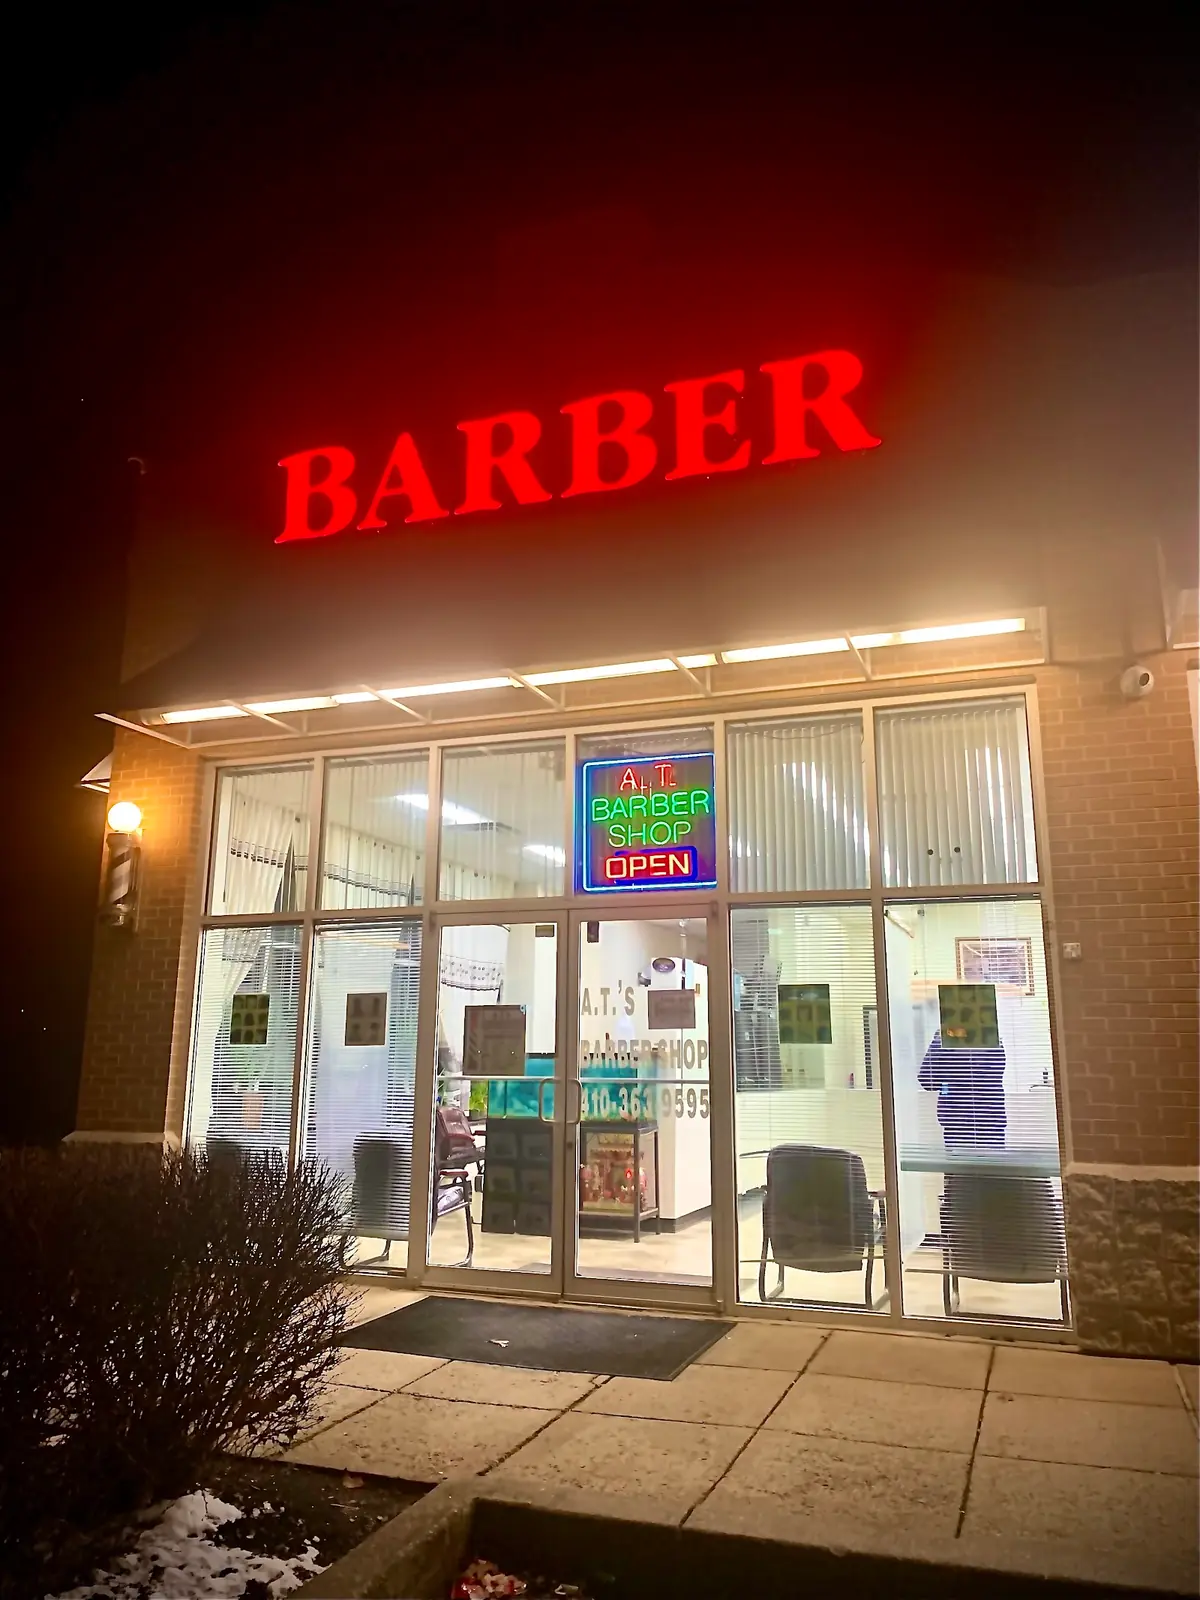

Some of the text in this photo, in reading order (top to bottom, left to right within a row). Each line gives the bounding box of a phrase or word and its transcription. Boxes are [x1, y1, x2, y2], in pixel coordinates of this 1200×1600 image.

[274, 349, 882, 544] BARBER
[591, 790, 710, 822] BARBER
[608, 821, 692, 848] SHOP
[605, 853, 690, 879] OPEN
[655, 1038, 709, 1070] SHOP
